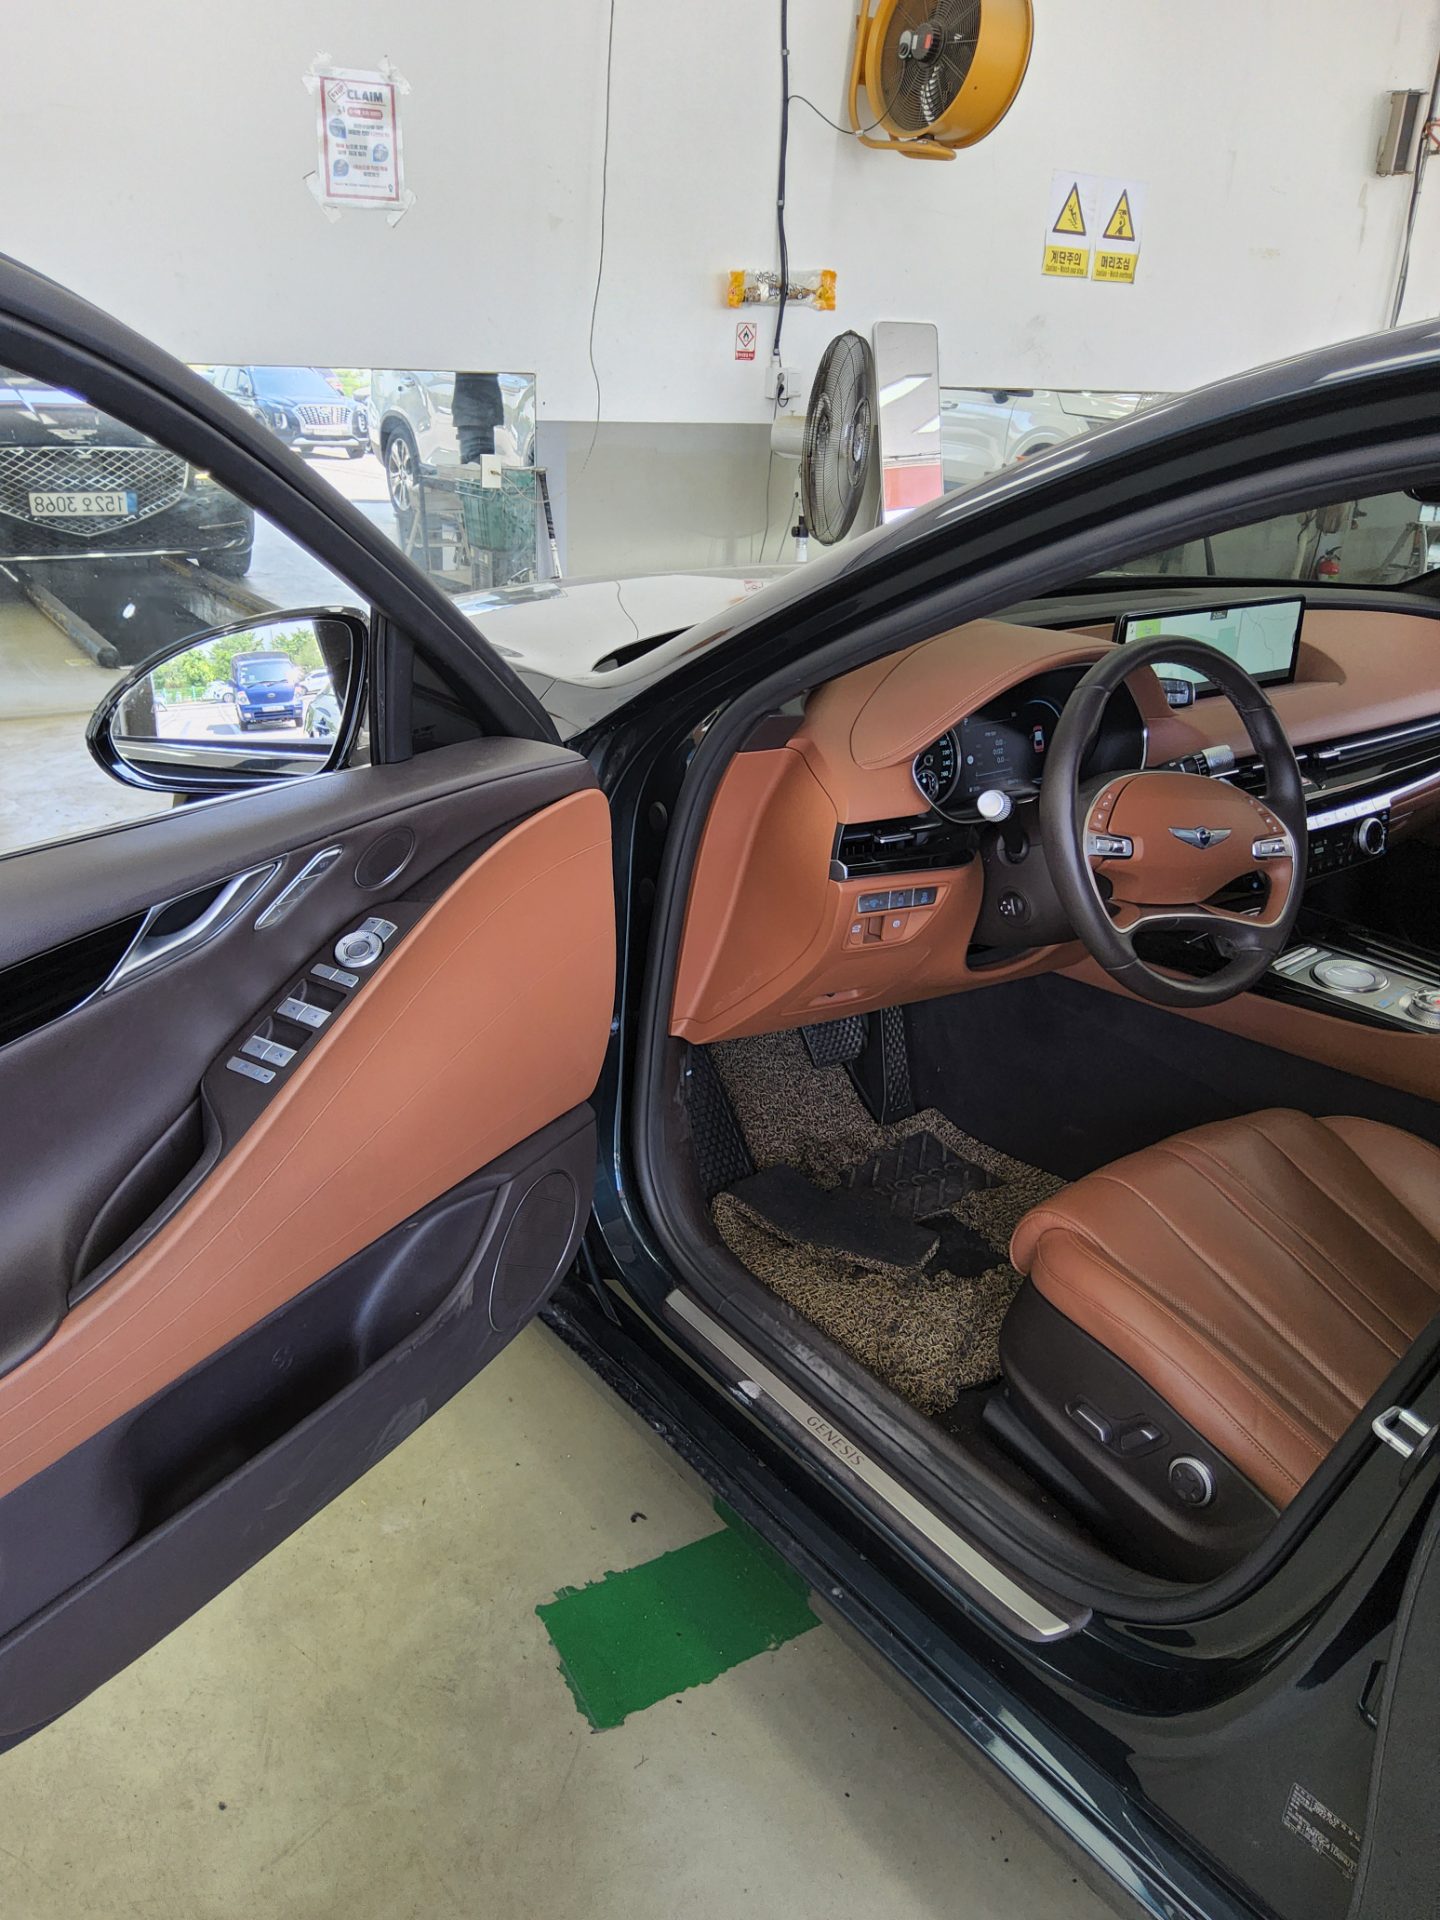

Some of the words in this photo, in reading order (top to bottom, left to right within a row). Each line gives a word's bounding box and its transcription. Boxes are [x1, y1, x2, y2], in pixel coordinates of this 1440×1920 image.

[347, 89, 383, 103] CLAIM
[1051, 250, 1082, 266] 계단주의
[1101, 255, 1131, 270] 머리조심
[806, 1416, 865, 1466] GENESIS
